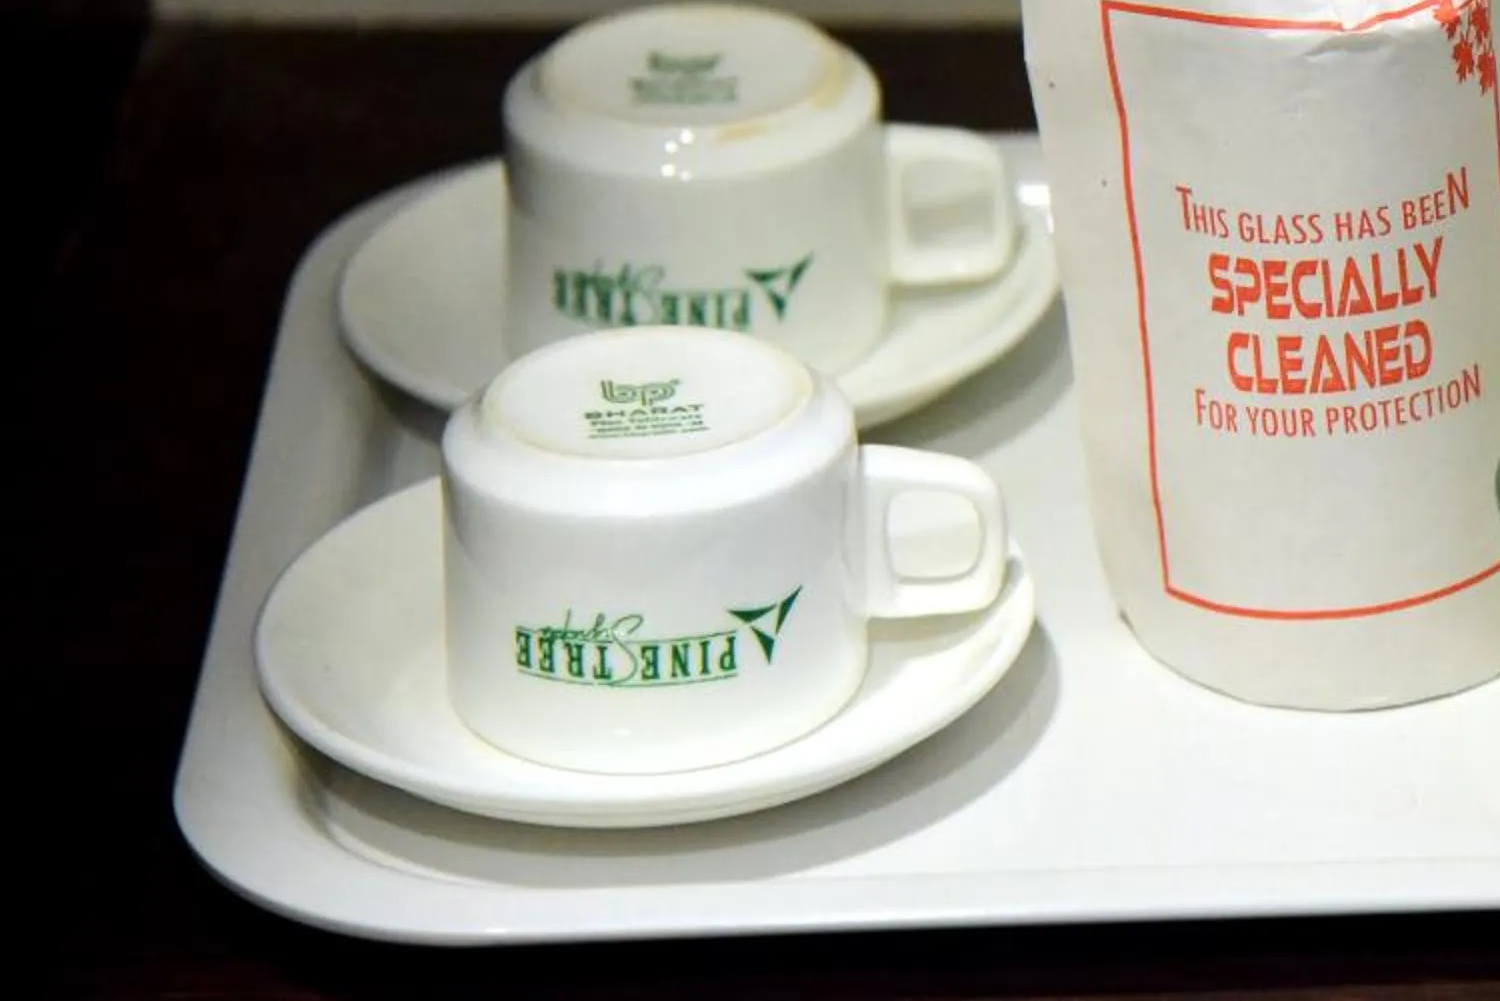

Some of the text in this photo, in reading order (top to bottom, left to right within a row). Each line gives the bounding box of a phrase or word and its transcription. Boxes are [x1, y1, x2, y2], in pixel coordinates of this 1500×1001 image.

[1175, 166, 1470, 245] THIS GLASS HAS BEEN
[1208, 236, 1443, 320] SPECIALLY
[1227, 318, 1433, 395] CLEANED
[1195, 364, 1481, 438] FOR YOUR PROTECTION
[515, 630, 737, 680] PINE TREE
